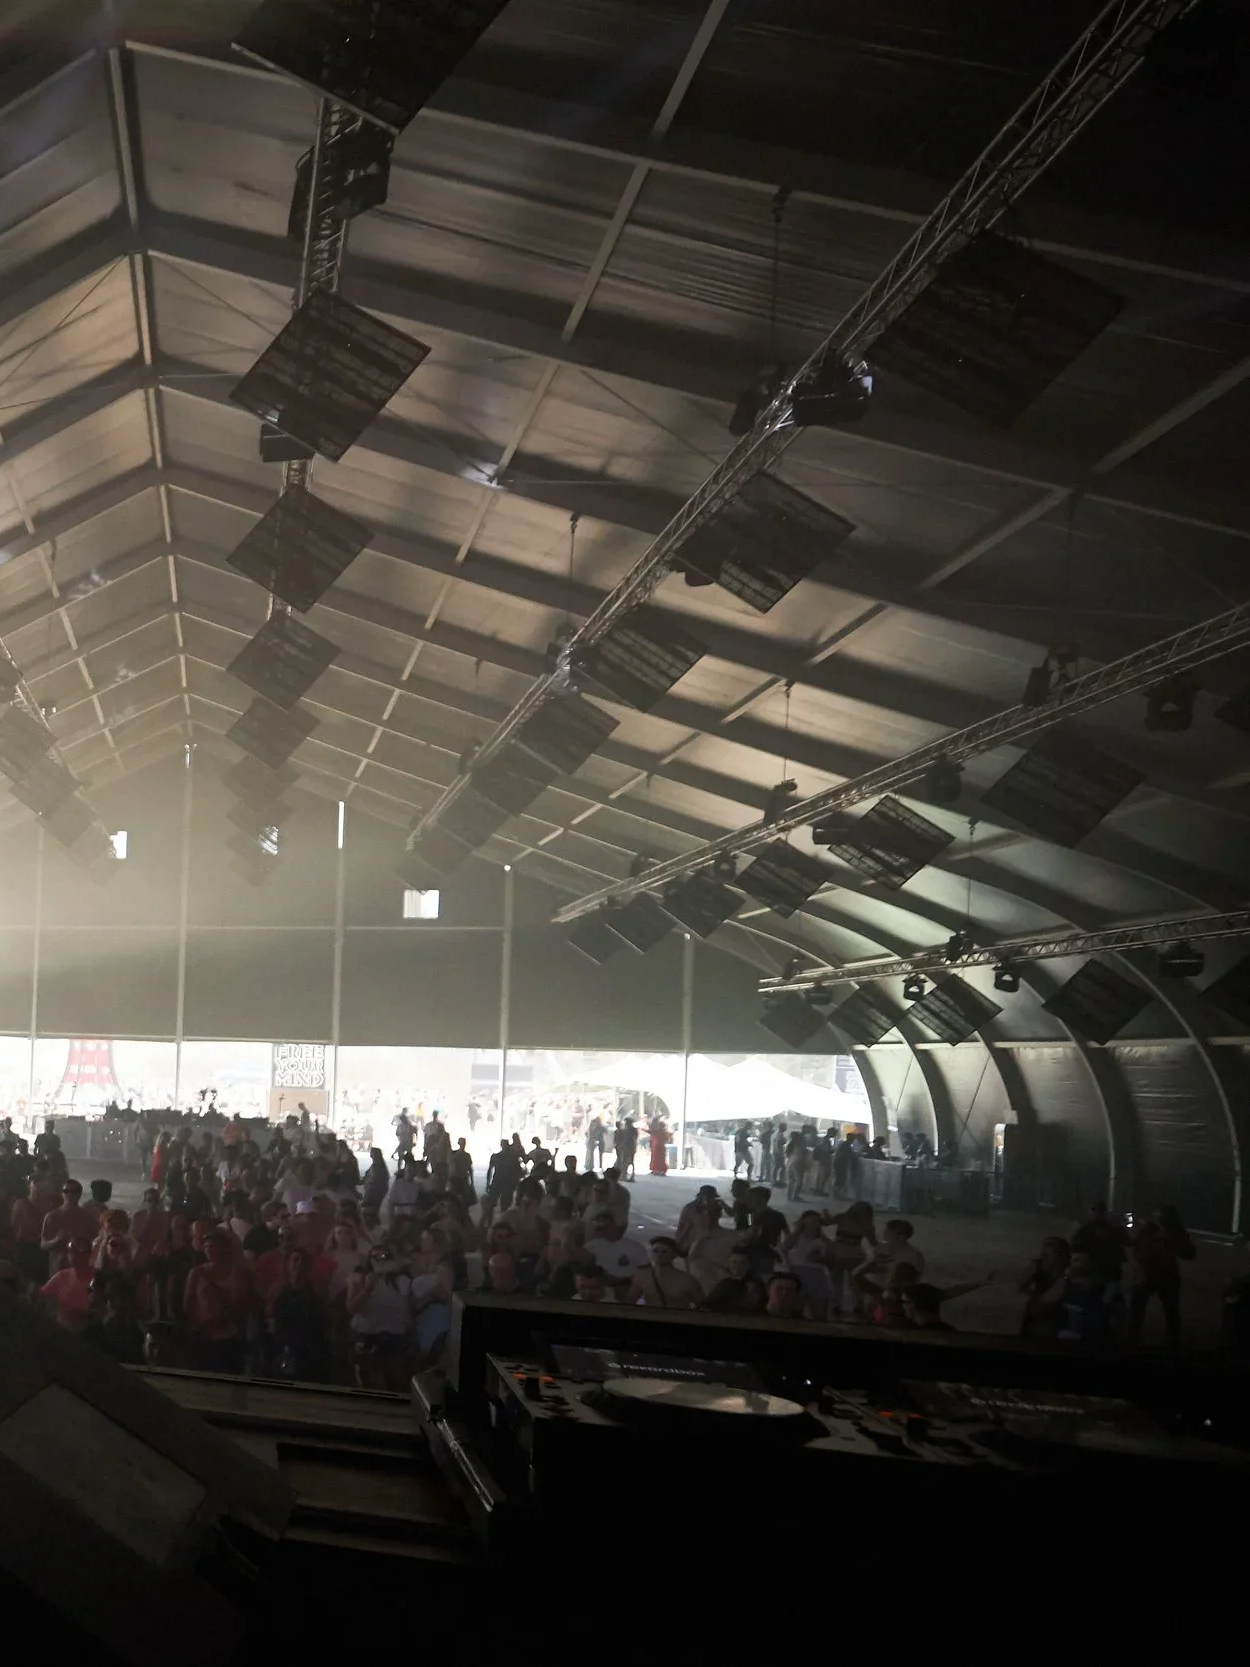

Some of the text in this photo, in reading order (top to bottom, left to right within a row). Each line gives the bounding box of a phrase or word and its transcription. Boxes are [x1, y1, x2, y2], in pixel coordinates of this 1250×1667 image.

[275, 1044, 325, 1059] FREE
[275, 1058, 325, 1073] YOUR
[275, 1072, 325, 1088] MIND
